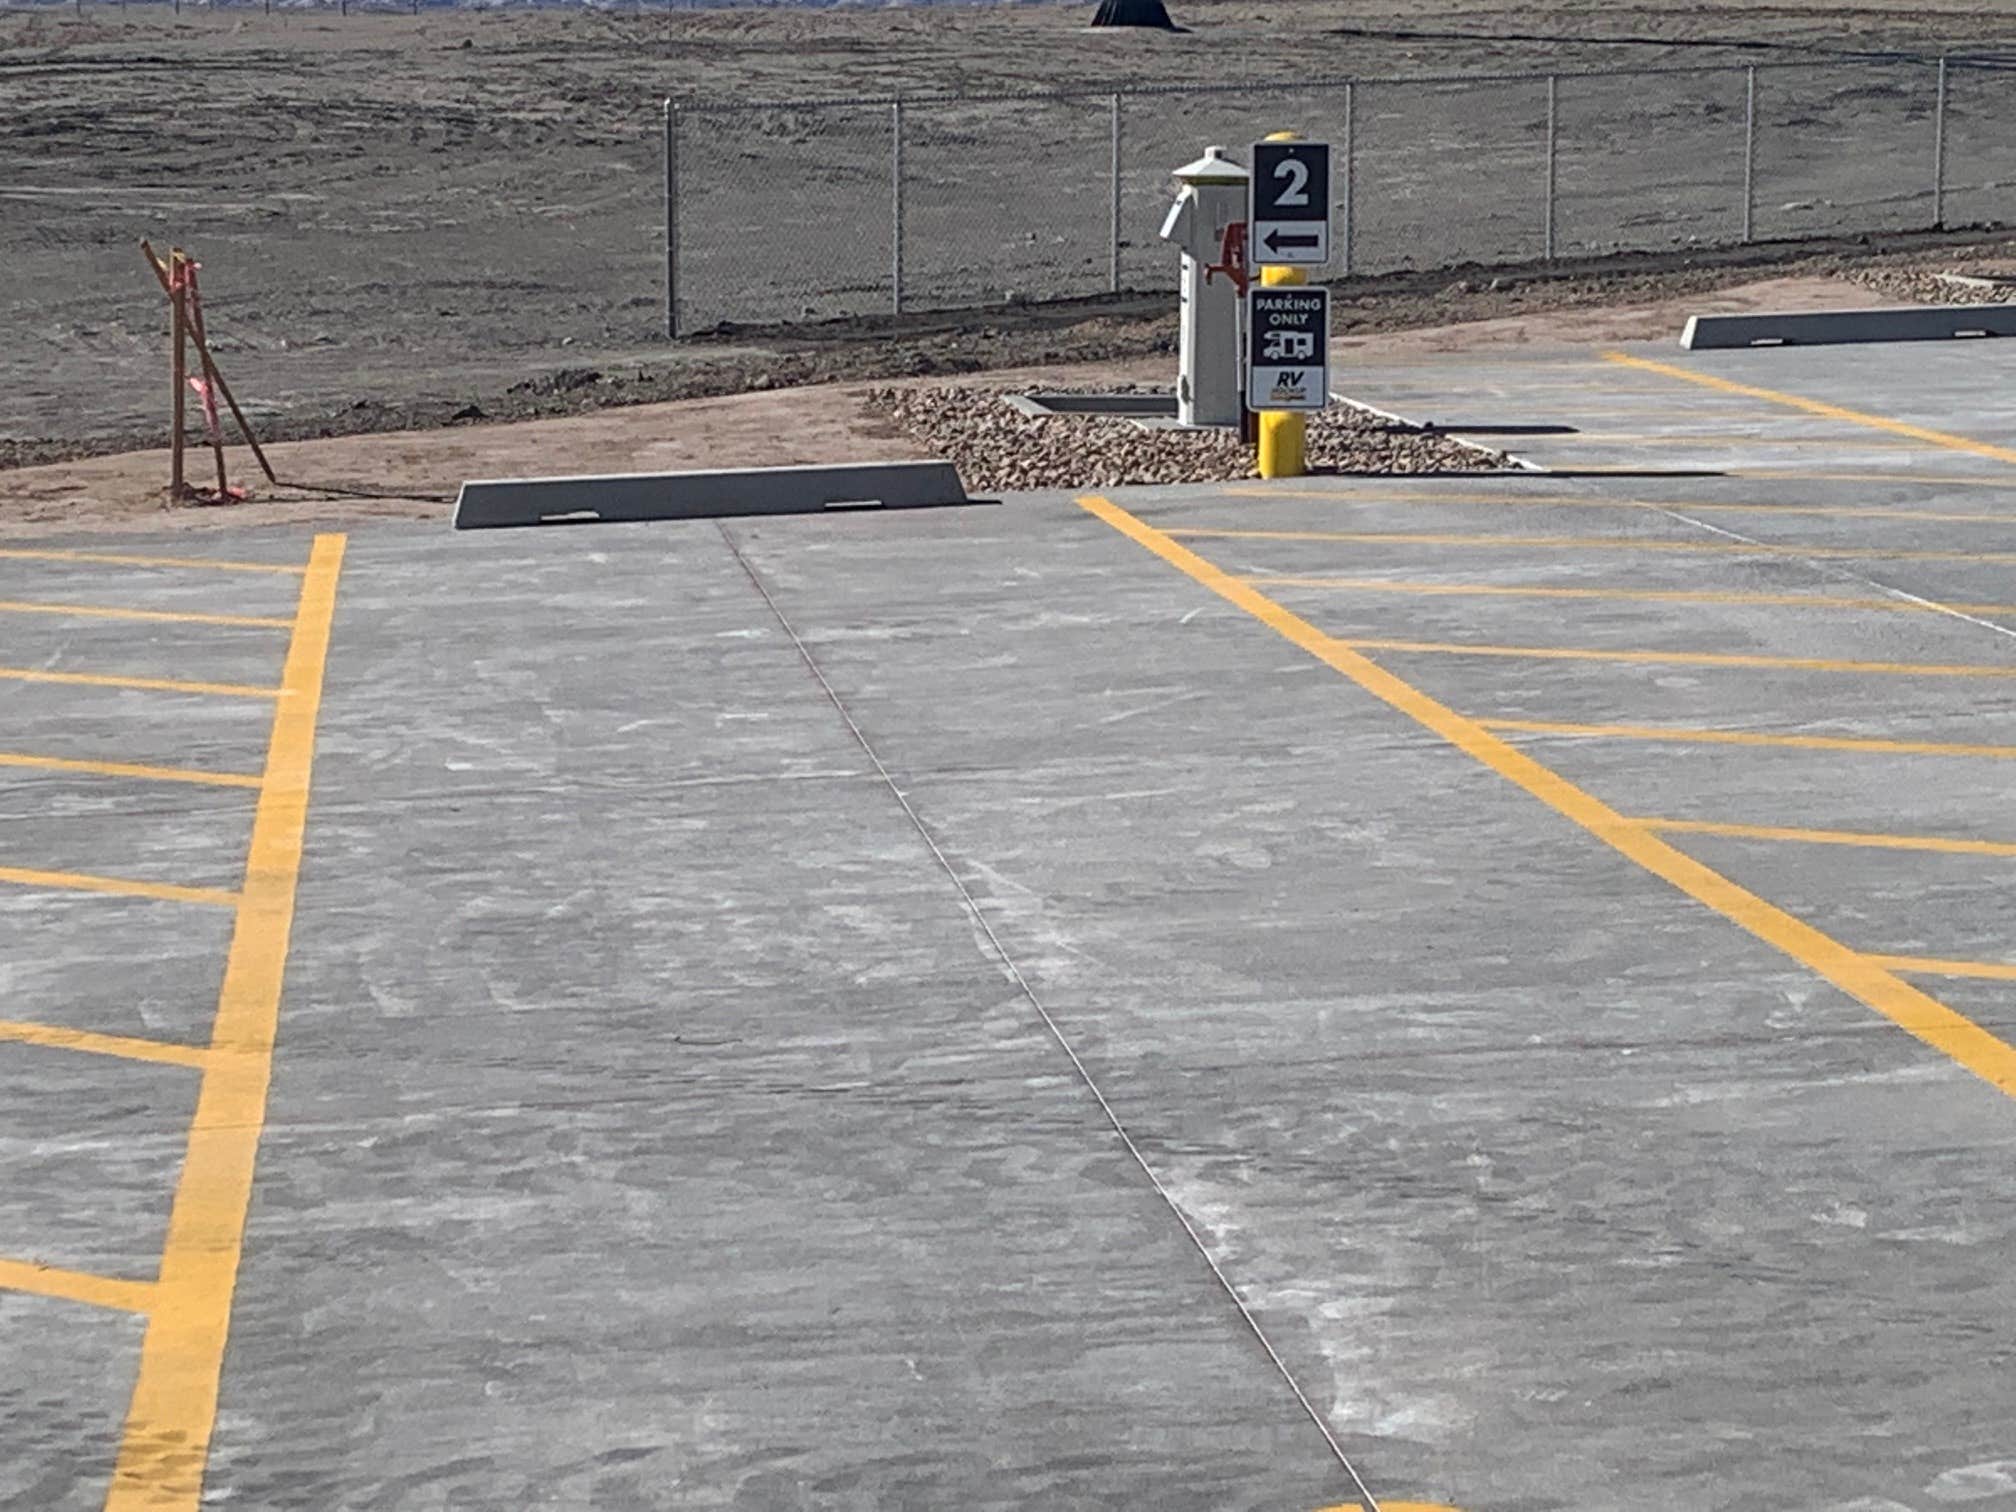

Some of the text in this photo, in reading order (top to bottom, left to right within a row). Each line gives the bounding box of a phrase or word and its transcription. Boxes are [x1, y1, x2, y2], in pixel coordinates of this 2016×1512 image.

[1273, 159, 1309, 205] 2
[1256, 298, 1321, 310] PARKING
[1269, 313, 1308, 325] ONLY
[1277, 371, 1305, 387] RV
